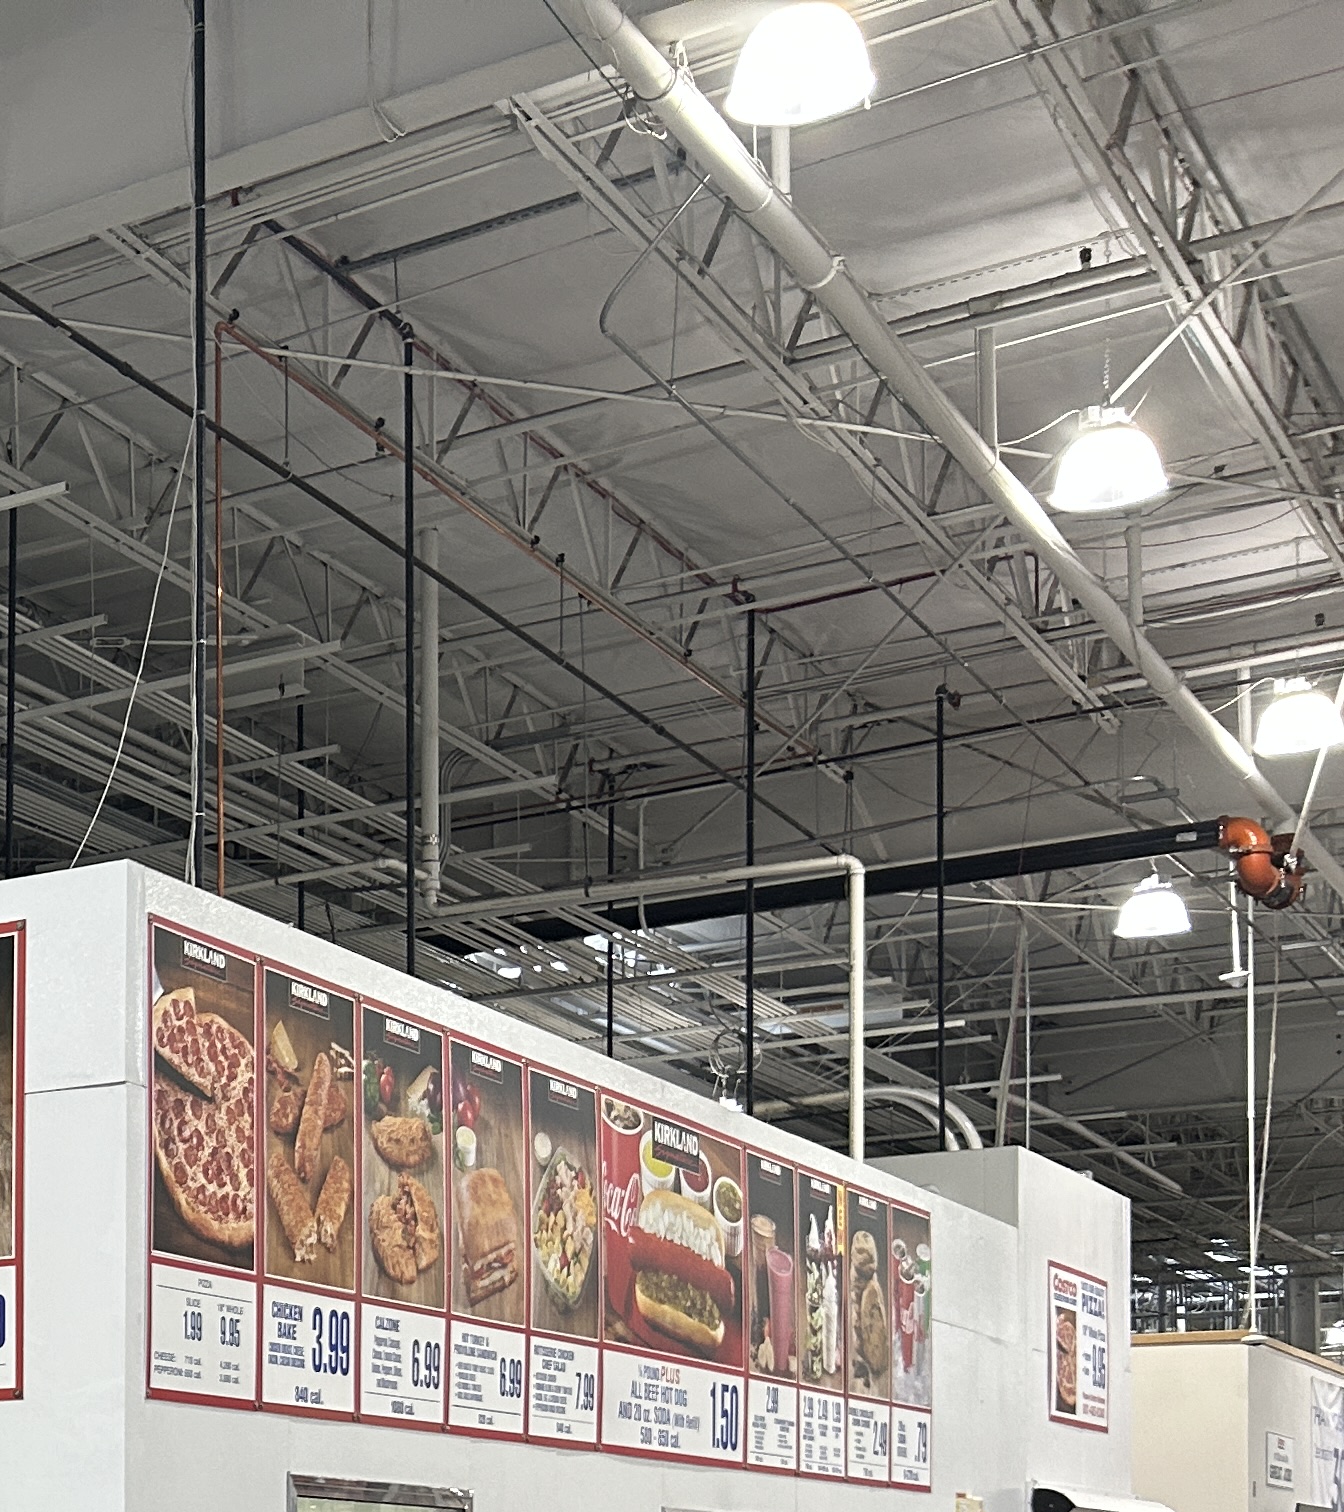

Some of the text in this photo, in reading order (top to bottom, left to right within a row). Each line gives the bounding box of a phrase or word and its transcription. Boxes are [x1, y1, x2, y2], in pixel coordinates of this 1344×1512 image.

[183, 940, 226, 969] KIRKLAND
[291, 981, 328, 1007] KIRKLAND
[654, 1121, 698, 1156] KIRKLAND
[183, 1311, 202, 1341] 1.99
[272, 1301, 303, 1322] CHICKEN
[278, 1322, 297, 1340] BAKE
[312, 1307, 350, 1377] 3.99
[412, 1339, 441, 1390] 6.99
[499, 1357, 522, 1399] 6.99
[661, 1366, 680, 1384] PLUS
[575, 1372, 595, 1411] 7.99
[631, 1380, 687, 1407] ALL BEEF HOT DOG
[618, 1401, 632, 1420] AND
[633, 1403, 642, 1421] 20
[653, 1406, 671, 1425] SODA
[710, 1382, 739, 1451] 1.50
